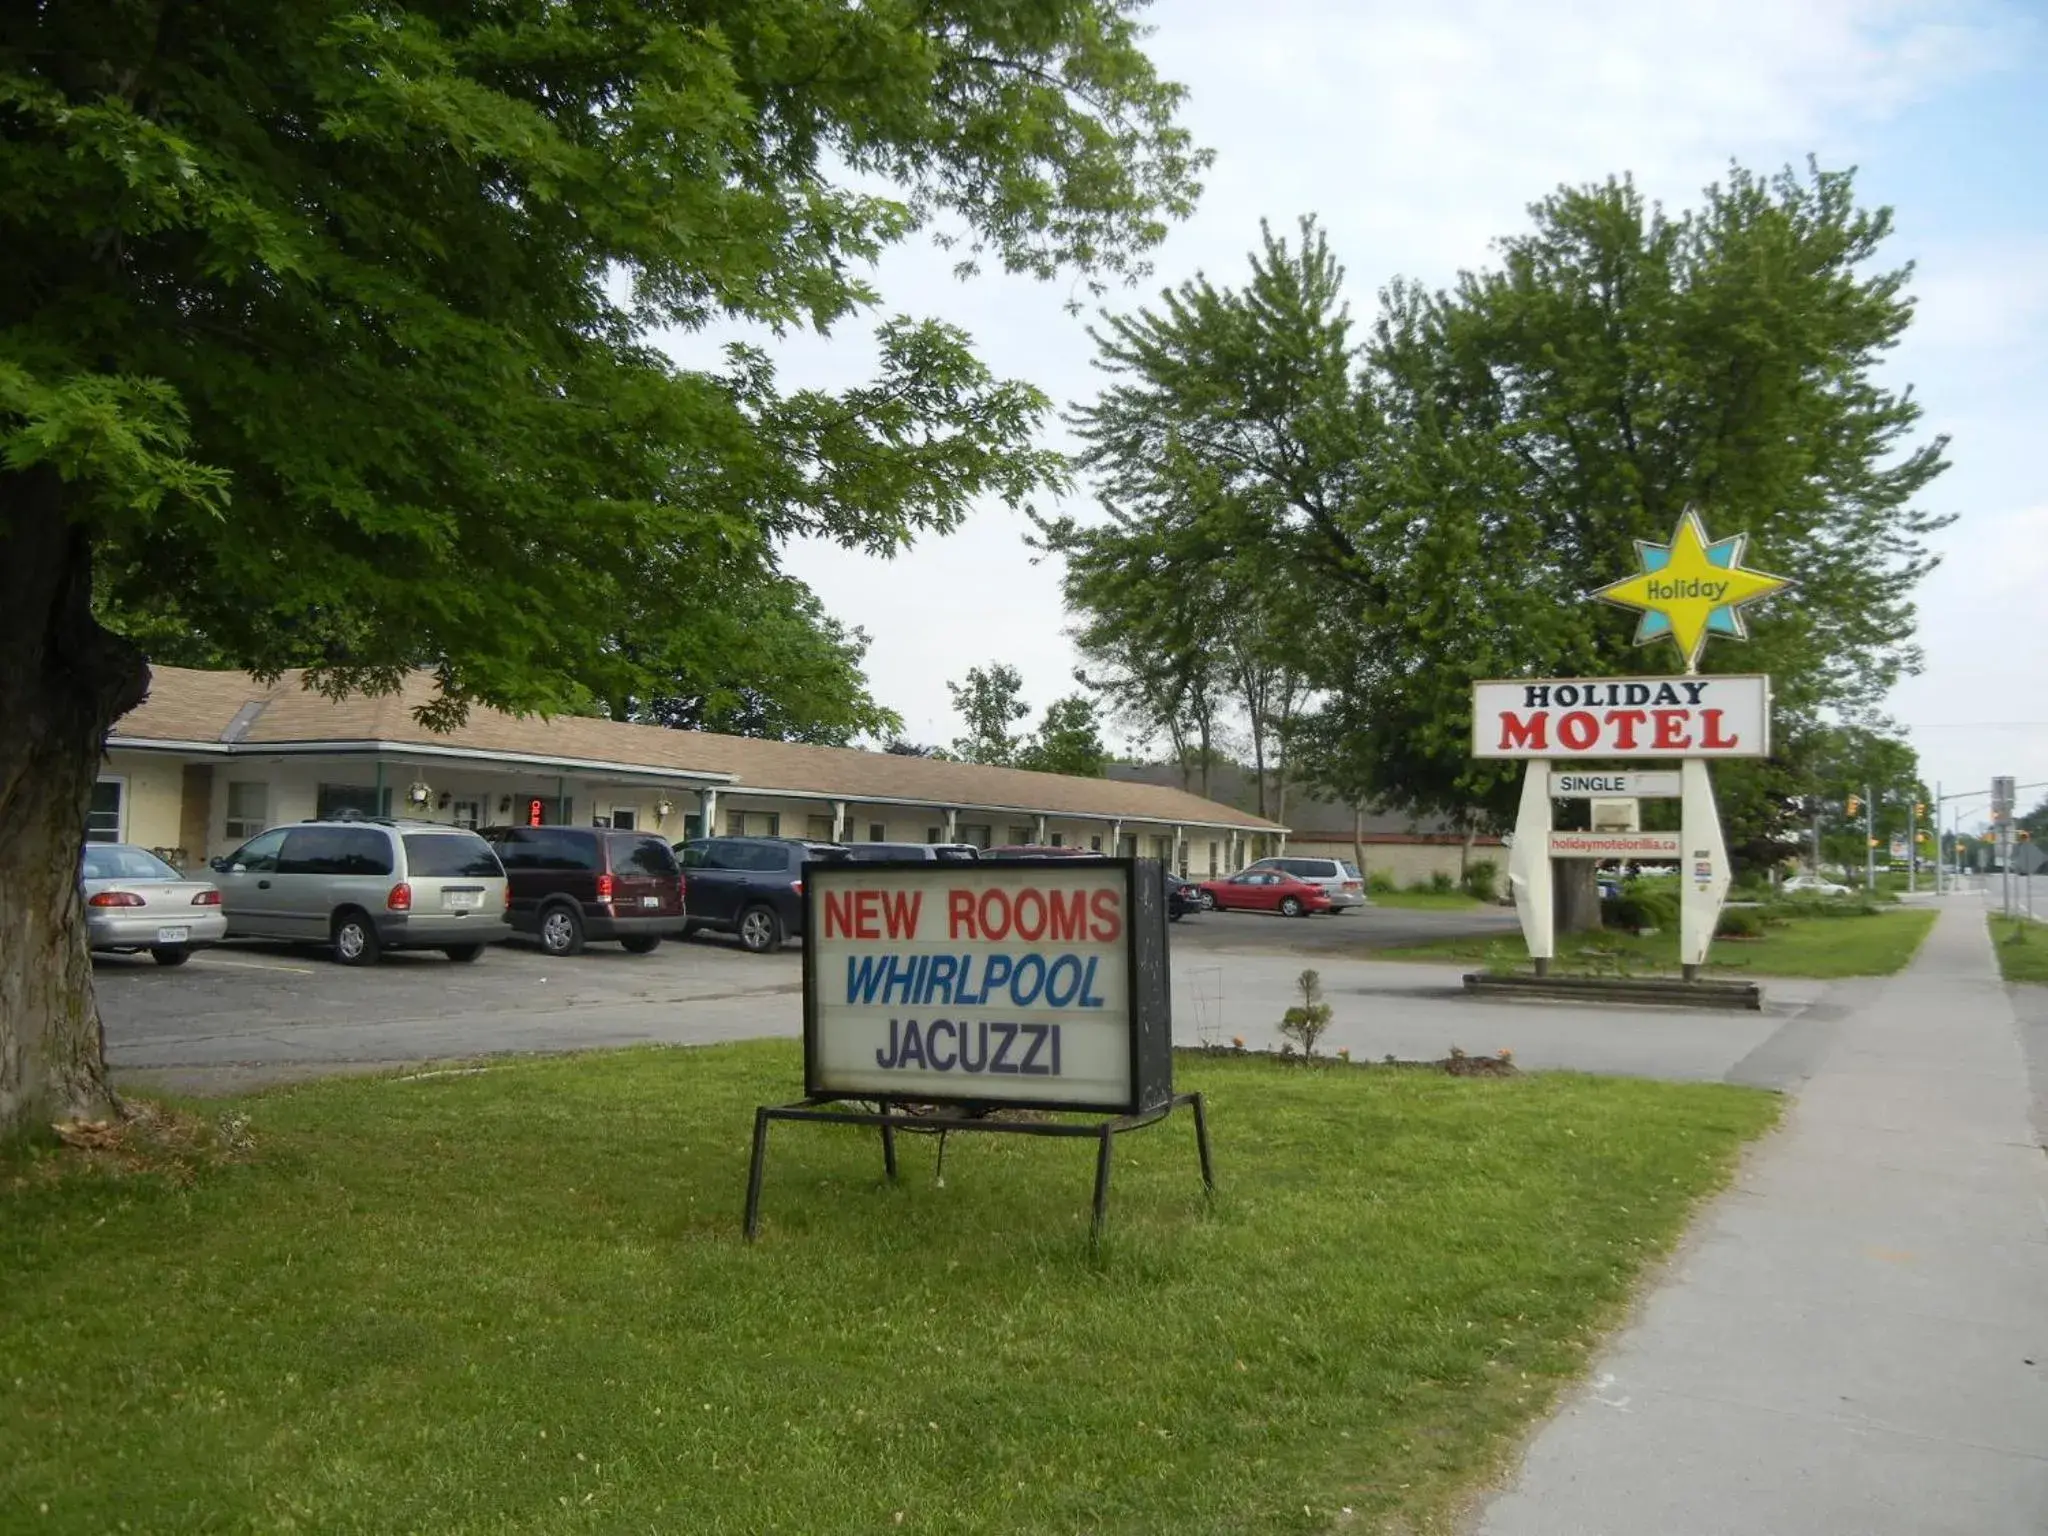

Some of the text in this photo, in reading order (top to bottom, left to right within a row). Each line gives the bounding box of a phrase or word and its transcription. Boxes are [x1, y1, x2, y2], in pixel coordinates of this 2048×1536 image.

[1646, 578, 1729, 602] Holiday
[1523, 682, 1709, 708] HOLIDAY
[1498, 709, 1738, 750] MOTEL
[1560, 776, 1625, 792] SINGLE
[824, 887, 1122, 942] NEW ROOMS
[846, 953, 1104, 1008] WHIRLPOOL
[876, 1019, 1061, 1076] JACUZZI
